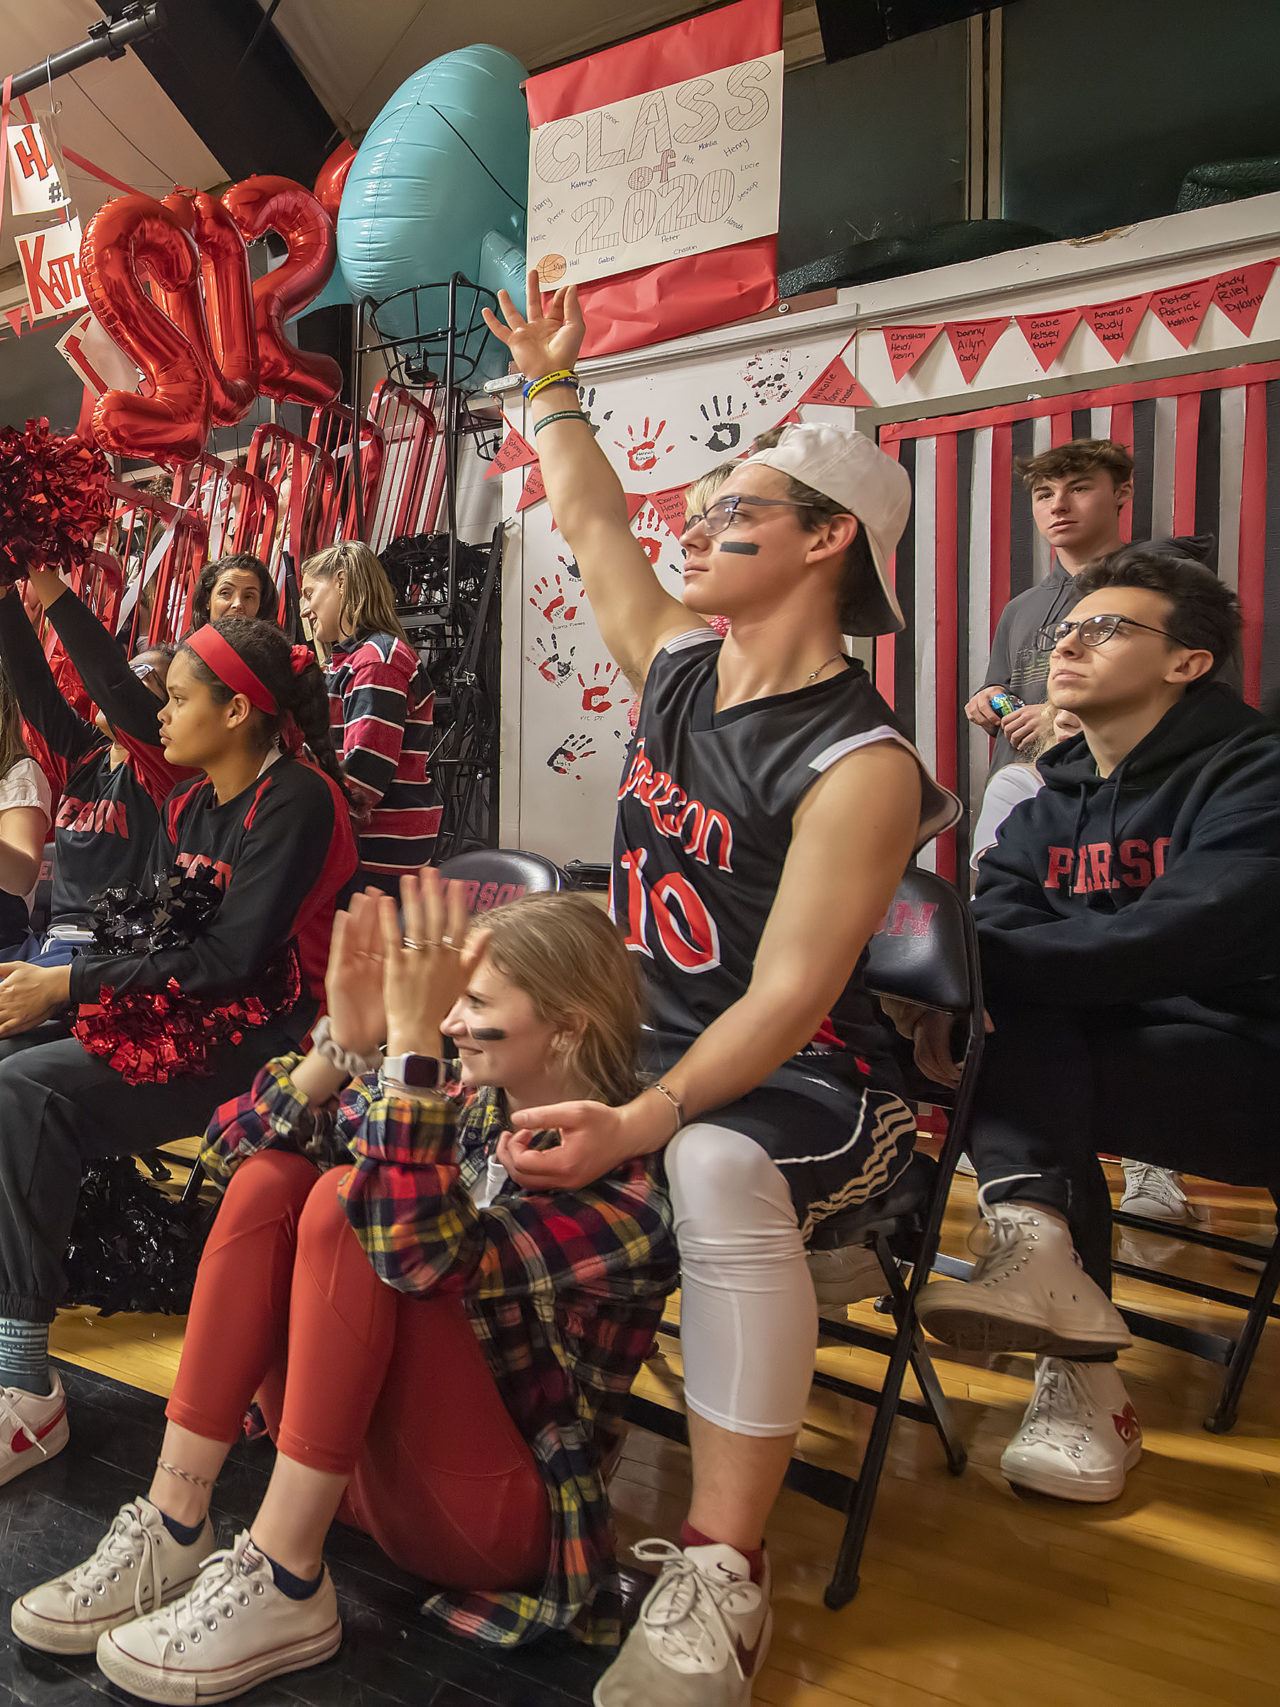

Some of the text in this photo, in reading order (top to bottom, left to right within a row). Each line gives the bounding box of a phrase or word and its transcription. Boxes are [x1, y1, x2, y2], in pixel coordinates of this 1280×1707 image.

[535, 60, 771, 184] CLASS
[723, 138, 750, 157] Henry
[628, 149, 676, 190] of
[571, 169, 735, 256] 2020
[661, 234, 680, 244] Peter
[1216, 274, 1245, 290] Andy
[1159, 290, 1199, 306] Peter
[1217, 284, 1249, 302] Riley
[1159, 300, 1201, 318] Patrick
[1030, 318, 1060, 330] Gabe
[1094, 319, 1124, 331] Rudy
[956, 327, 986, 338] Danny
[1030, 330, 1060, 341] Kelsey
[1032, 341, 1057, 350] Matt
[620, 848, 721, 974] 10
